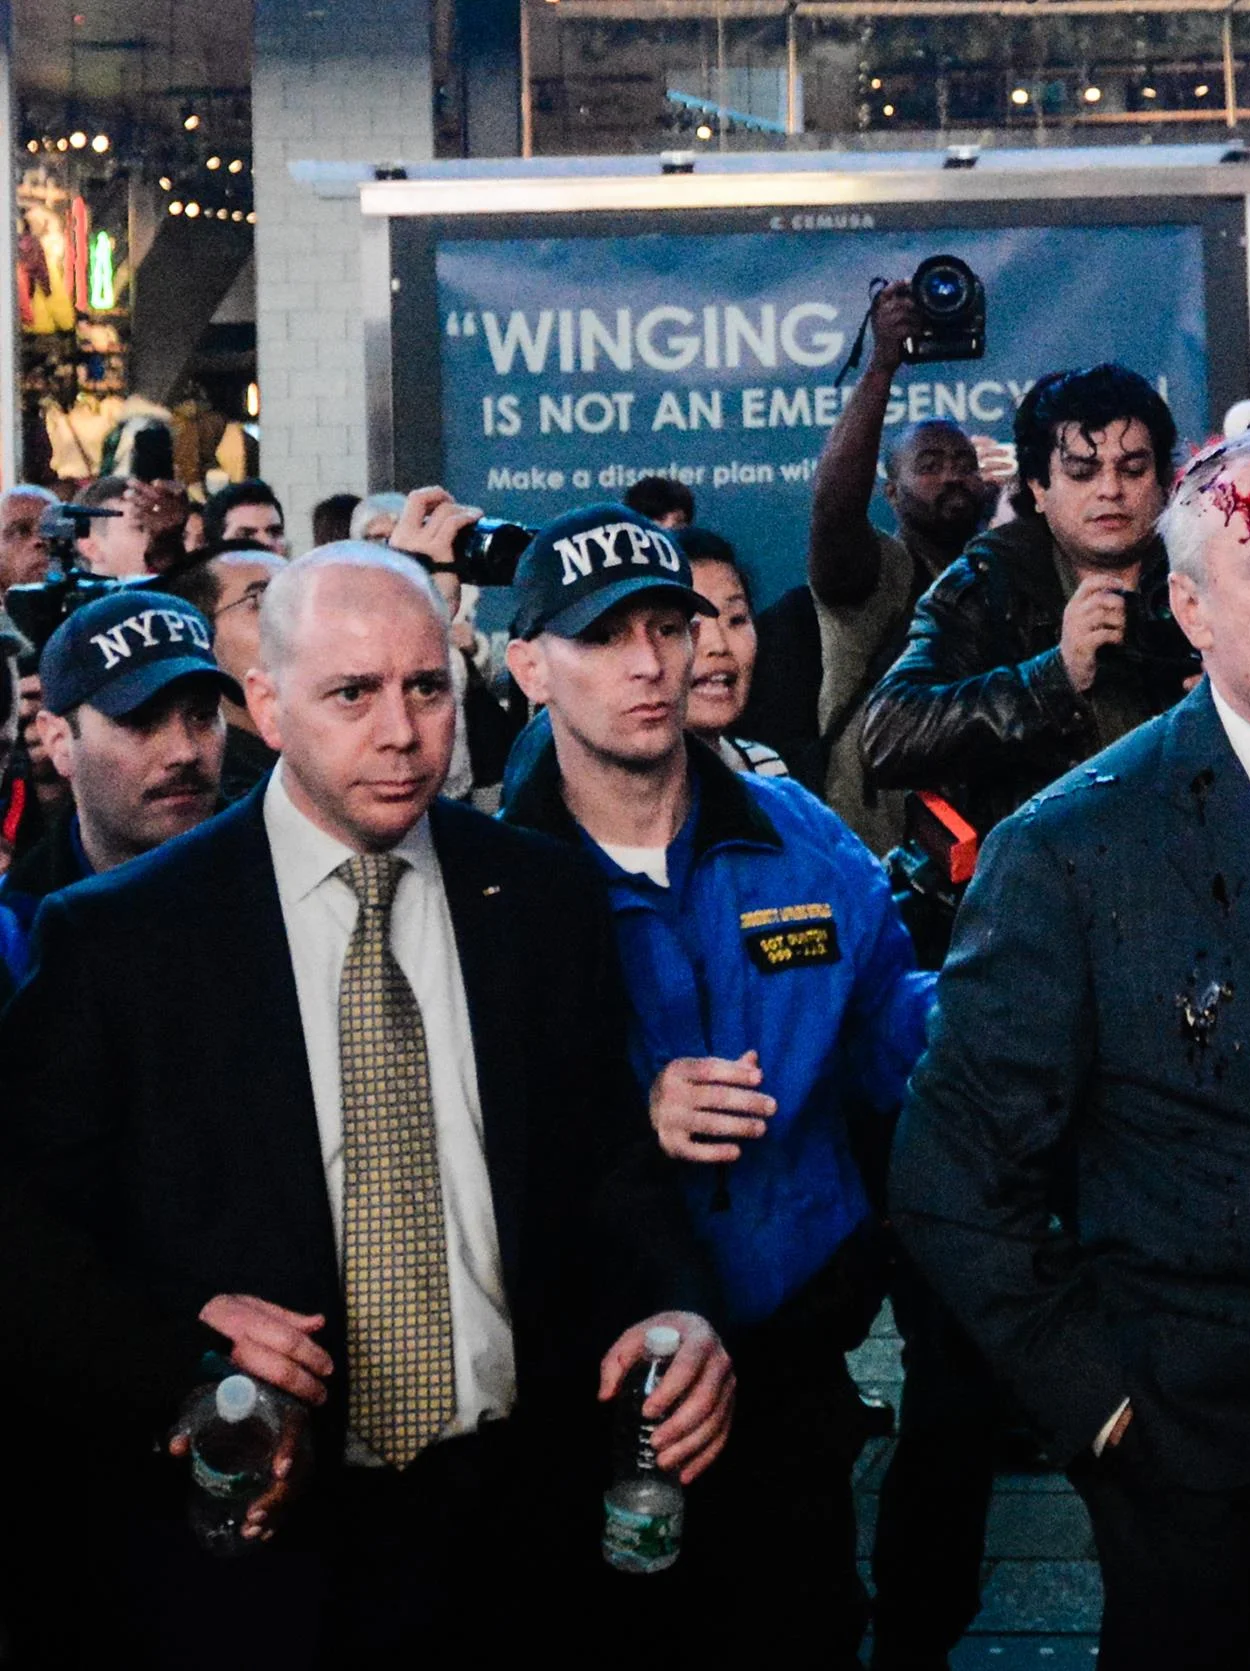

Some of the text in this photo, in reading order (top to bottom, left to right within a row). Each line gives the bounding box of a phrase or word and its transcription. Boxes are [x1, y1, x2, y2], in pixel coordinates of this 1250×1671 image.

[482, 394, 522, 436] IS
[539, 391, 635, 434] NOT
[651, 389, 724, 432] AN
[487, 466, 566, 491] Make
[572, 470, 591, 489] a
[713, 460, 774, 488] plan
[553, 522, 680, 586] NYPD
[90, 609, 210, 669] NYPD
